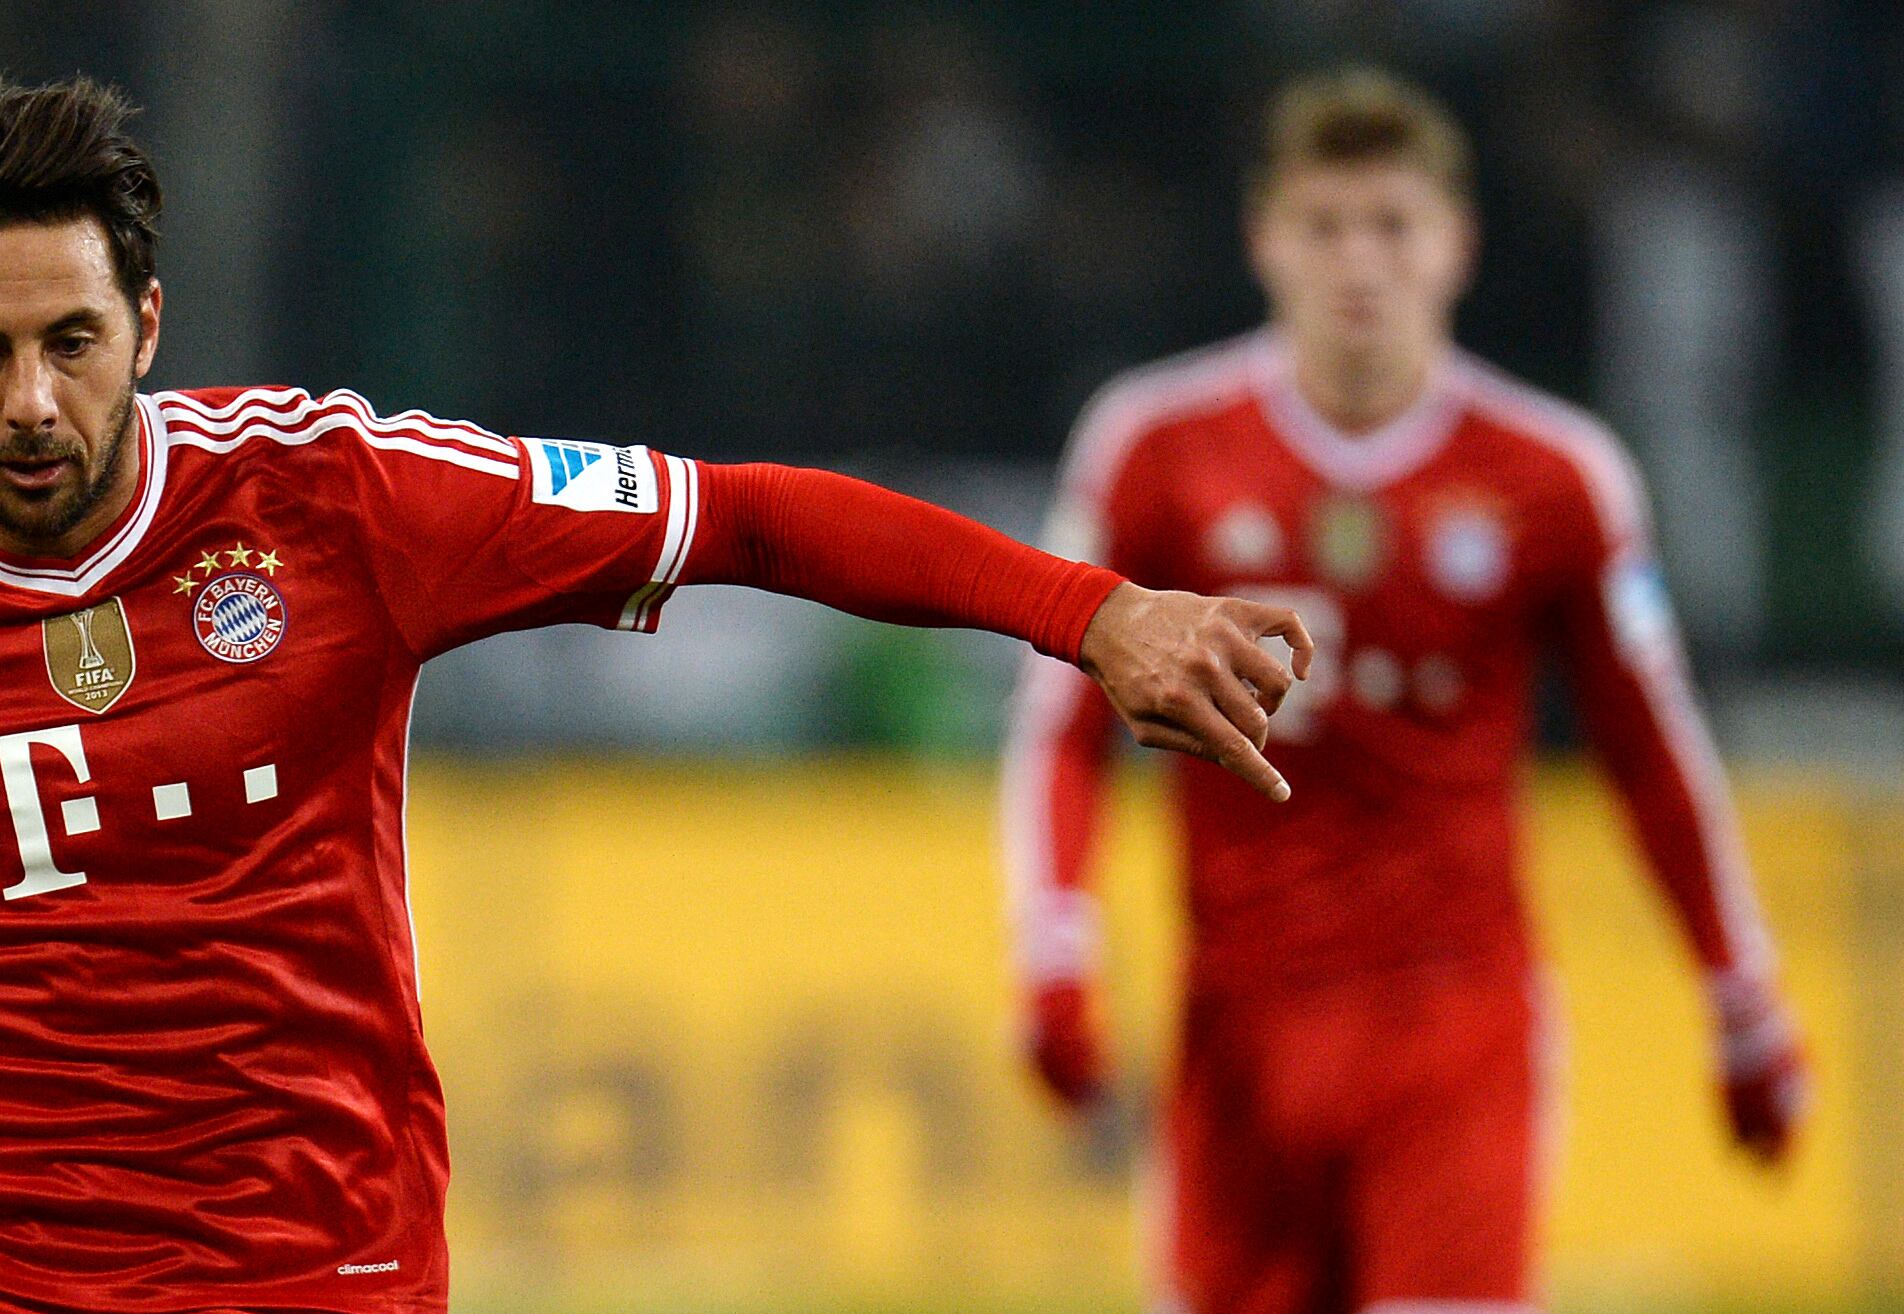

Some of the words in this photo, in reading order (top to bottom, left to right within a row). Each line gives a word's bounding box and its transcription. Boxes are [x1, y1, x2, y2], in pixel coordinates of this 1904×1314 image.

[198, 598, 214, 622] FC
[210, 578, 278, 610] BAYERN
[75, 668, 114, 687] FIFA
[84, 689, 108, 700] 2013
[337, 1260, 400, 1275] climacool
